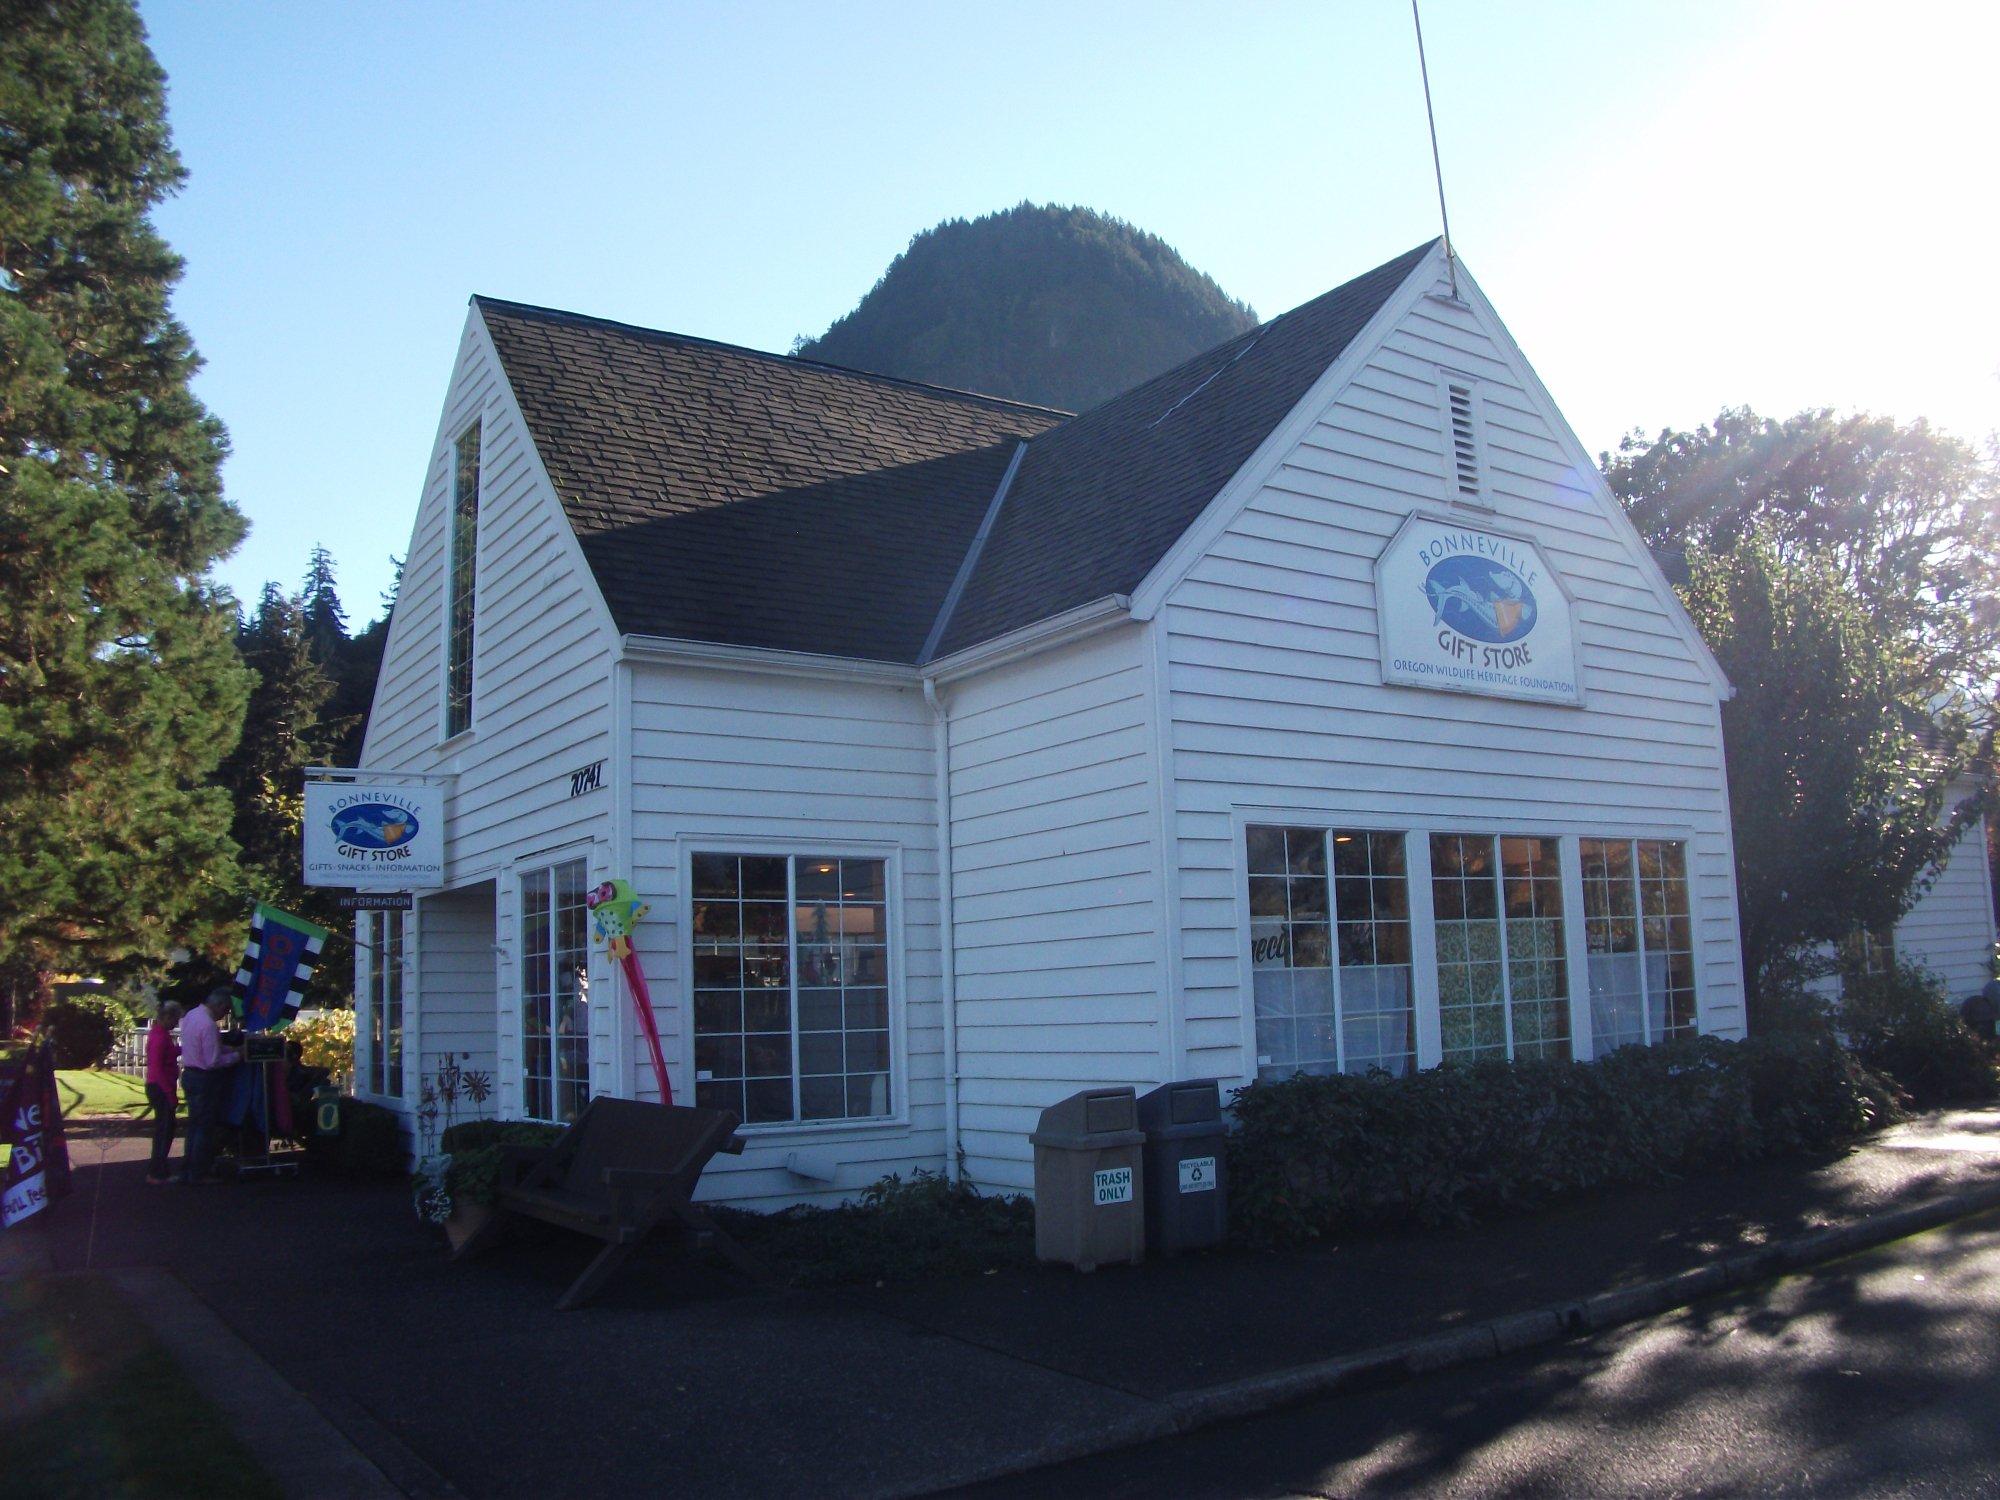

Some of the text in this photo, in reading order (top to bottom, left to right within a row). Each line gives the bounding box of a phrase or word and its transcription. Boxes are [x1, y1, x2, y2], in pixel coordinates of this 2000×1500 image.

[1419, 533, 1537, 586] BONNEVILLE
[1438, 630, 1532, 670] GIFT STORE
[1393, 659, 1574, 693] OREGON WILDLIFE HERITAGE FOUNDATION
[328, 792, 422, 816] BONNEVILLE
[337, 844, 412, 862] GIFT STORE
[309, 863, 441, 872] GIFTS SNACKS INFORMATION
[340, 897, 410, 907] INFORMATION
[1096, 1171, 1130, 1187] TRASH
[1099, 1187, 1126, 1201] ONLY
